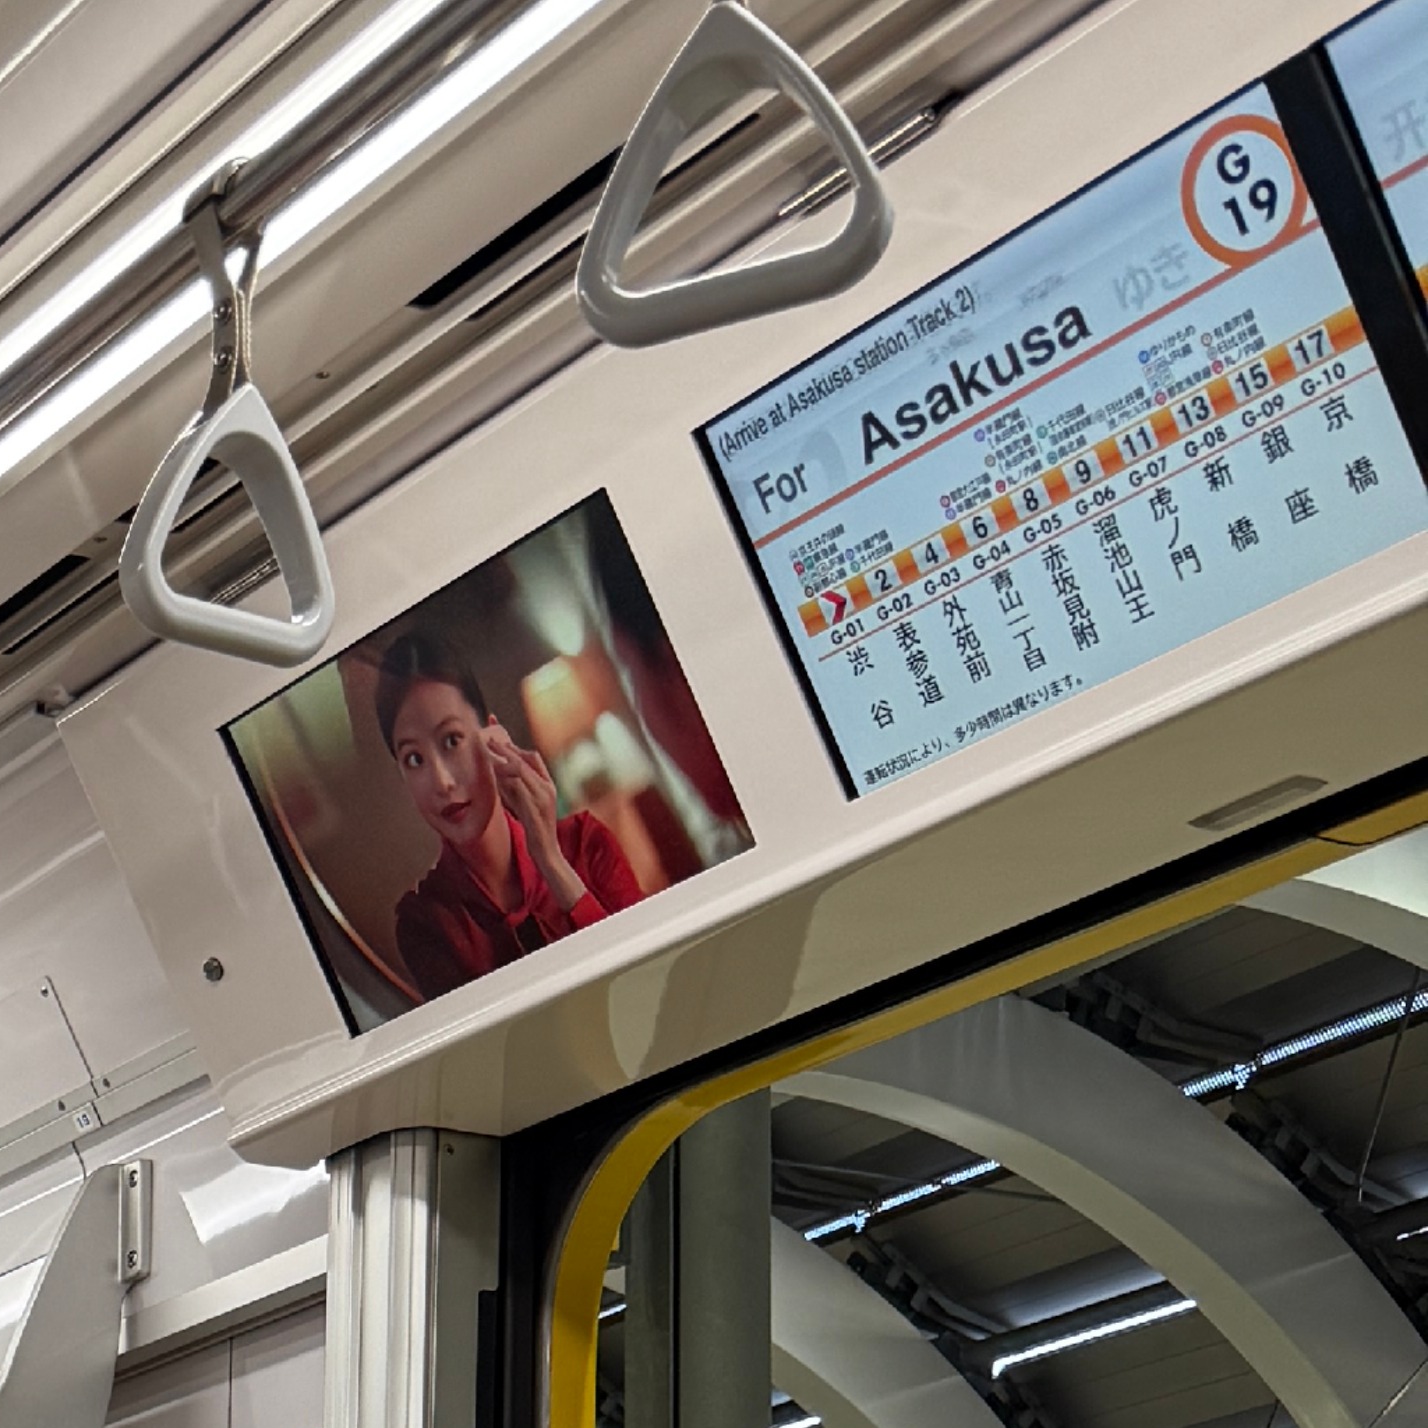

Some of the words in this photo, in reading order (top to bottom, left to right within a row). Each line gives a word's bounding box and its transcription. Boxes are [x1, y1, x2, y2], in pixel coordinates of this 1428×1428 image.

[1215, 142, 1253, 185] G
[1223, 176, 1280, 237] 19
[1293, 328, 1328, 366] 17
[718, 415, 770, 463] (Arrive
[767, 402, 788, 427] at
[786, 363, 854, 421] Asakusa
[853, 327, 911, 375] station
[906, 299, 957, 341] Track
[954, 285, 978, 315] 2)
[1235, 362, 1270, 399] 15
[1300, 360, 1349, 398] G-10
[751, 462, 809, 516] For
[859, 305, 1094, 467] Asakusa
[1177, 395, 1212, 429] 13
[1240, 392, 1287, 429] G-09
[1122, 425, 1154, 459] 11
[1183, 424, 1230, 460] G-08
[1318, 392, 1381, 496] 京橋
[1074, 458, 1092, 485] 9
[1128, 455, 1170, 489] G-07
[1259, 423, 1321, 526] 銀座
[1021, 487, 1040, 513] 8
[1074, 484, 1118, 517] G-06
[1201, 454, 1261, 554] 新橋
[971, 515, 990, 540] 6
[1022, 512, 1064, 544] G-05
[1147, 485, 1204, 582] 虎ノ門
[923, 541, 941, 565] 4
[971, 538, 1013, 571] G-04
[1091, 511, 1156, 626] 溜池山王
[873, 568, 893, 596] 2
[923, 565, 962, 597] G-03
[1039, 542, 1101, 652] 赤坂見附
[875, 591, 915, 622] G-02
[989, 567, 1048, 674] 青山一丁目
[830, 617, 867, 647] G-01
[941, 593, 994, 685] 外苑前
[892, 620, 947, 709] 表参道
[844, 644, 896, 730] 渋谷
[861, 672, 1085, 788] 運転状況により、多少時間は異なります。
